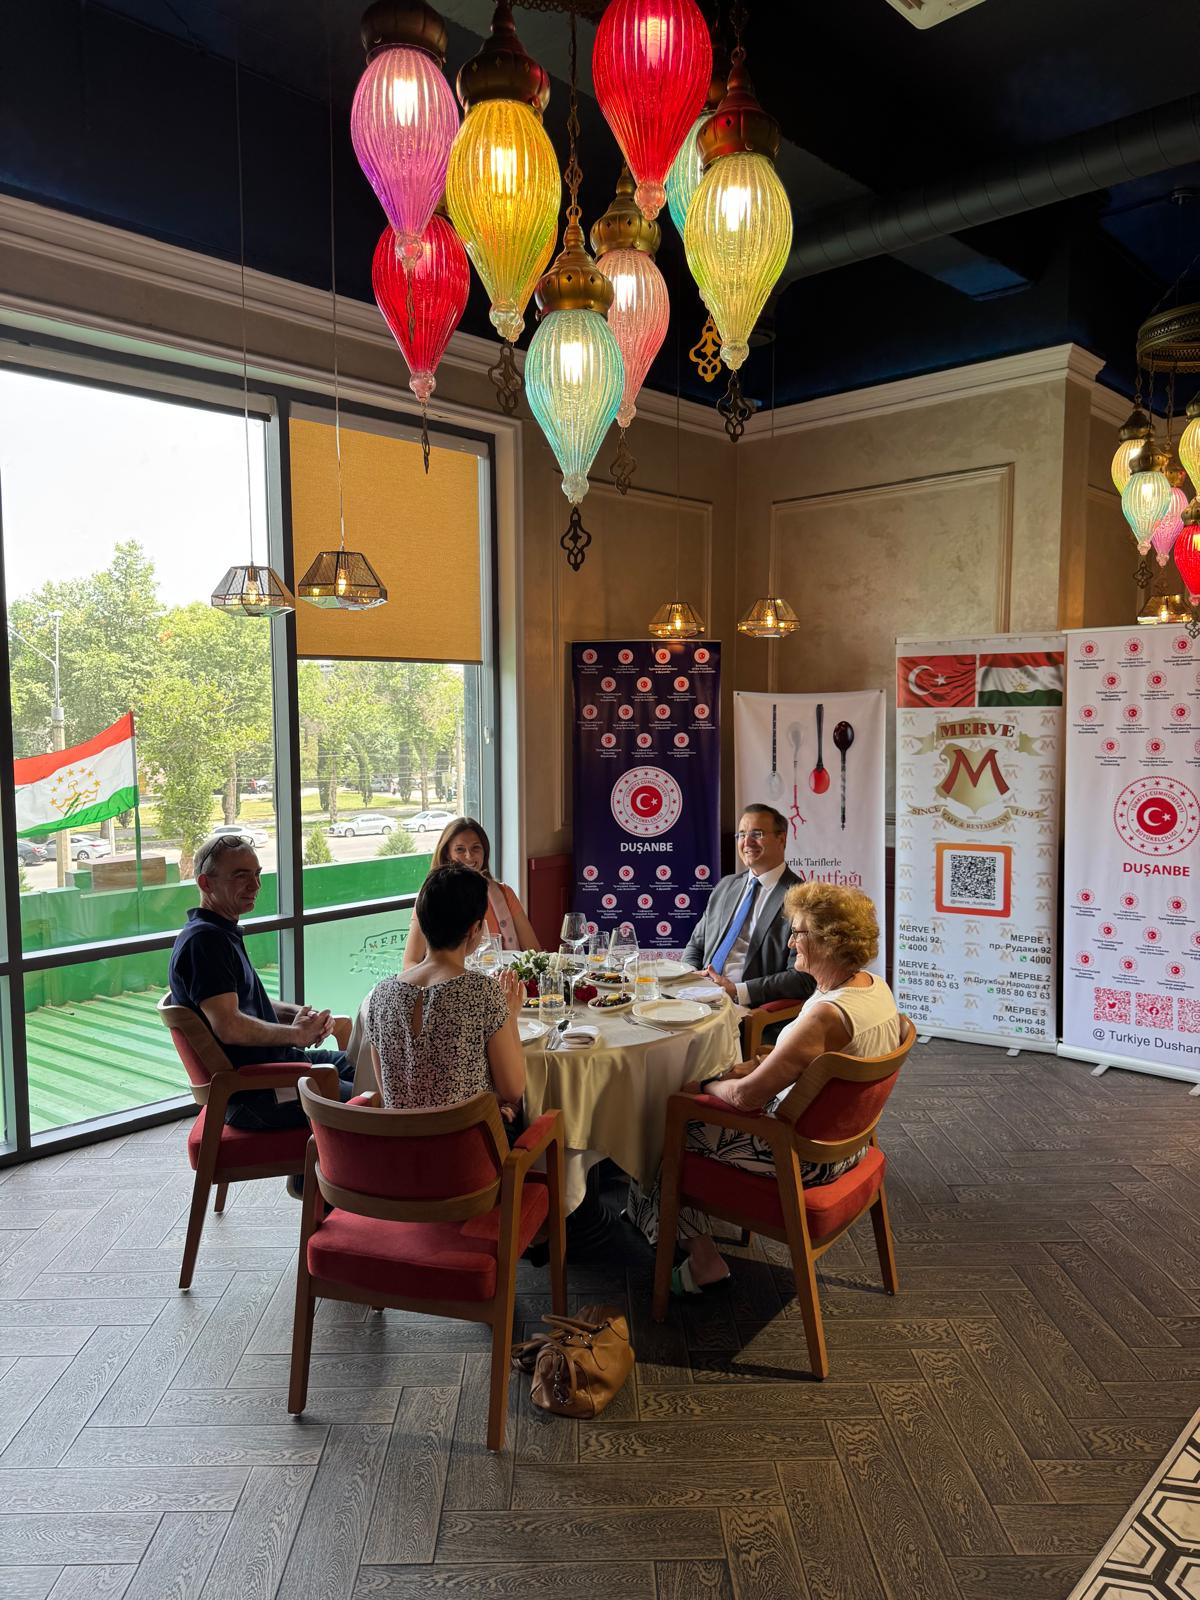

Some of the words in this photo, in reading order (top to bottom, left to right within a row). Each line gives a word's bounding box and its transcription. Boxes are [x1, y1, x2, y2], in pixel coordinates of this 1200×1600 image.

[940, 722, 1016, 738] MERVE
[940, 749, 1010, 796] M
[912, 806, 941, 816] SINCE
[1015, 810, 1040, 818] 1997
[966, 814, 1010, 830] RESTAURANT
[620, 842, 673, 854] DUŞANBE
[786, 857, 803, 866] ırlık
[804, 857, 842, 866] Tariflerle
[1123, 862, 1190, 877] DUŞANBE
[900, 924, 930, 934] MERVE
[900, 934, 928, 942] Rudaki
[1010, 934, 1044, 944] МЕРВЕ
[1005, 944, 1038, 953] Рудаки
[899, 960, 929, 969] MERVE
[1030, 956, 1051, 964] 4000
[908, 977, 922, 985] 985
[1010, 972, 1043, 981] МЕРВЕ
[996, 987, 1011, 996] 985
[899, 993, 929, 1002] MERVE
[899, 1002, 917, 1010] Sino
[1005, 1006, 1038, 1015] МЕРВЕ
[1009, 1015, 1032, 1024] Сино
[1024, 1027, 1046, 1035] 3636
[1092, 1028, 1105, 1041] @
[1109, 1030, 1150, 1047] Turkiye
